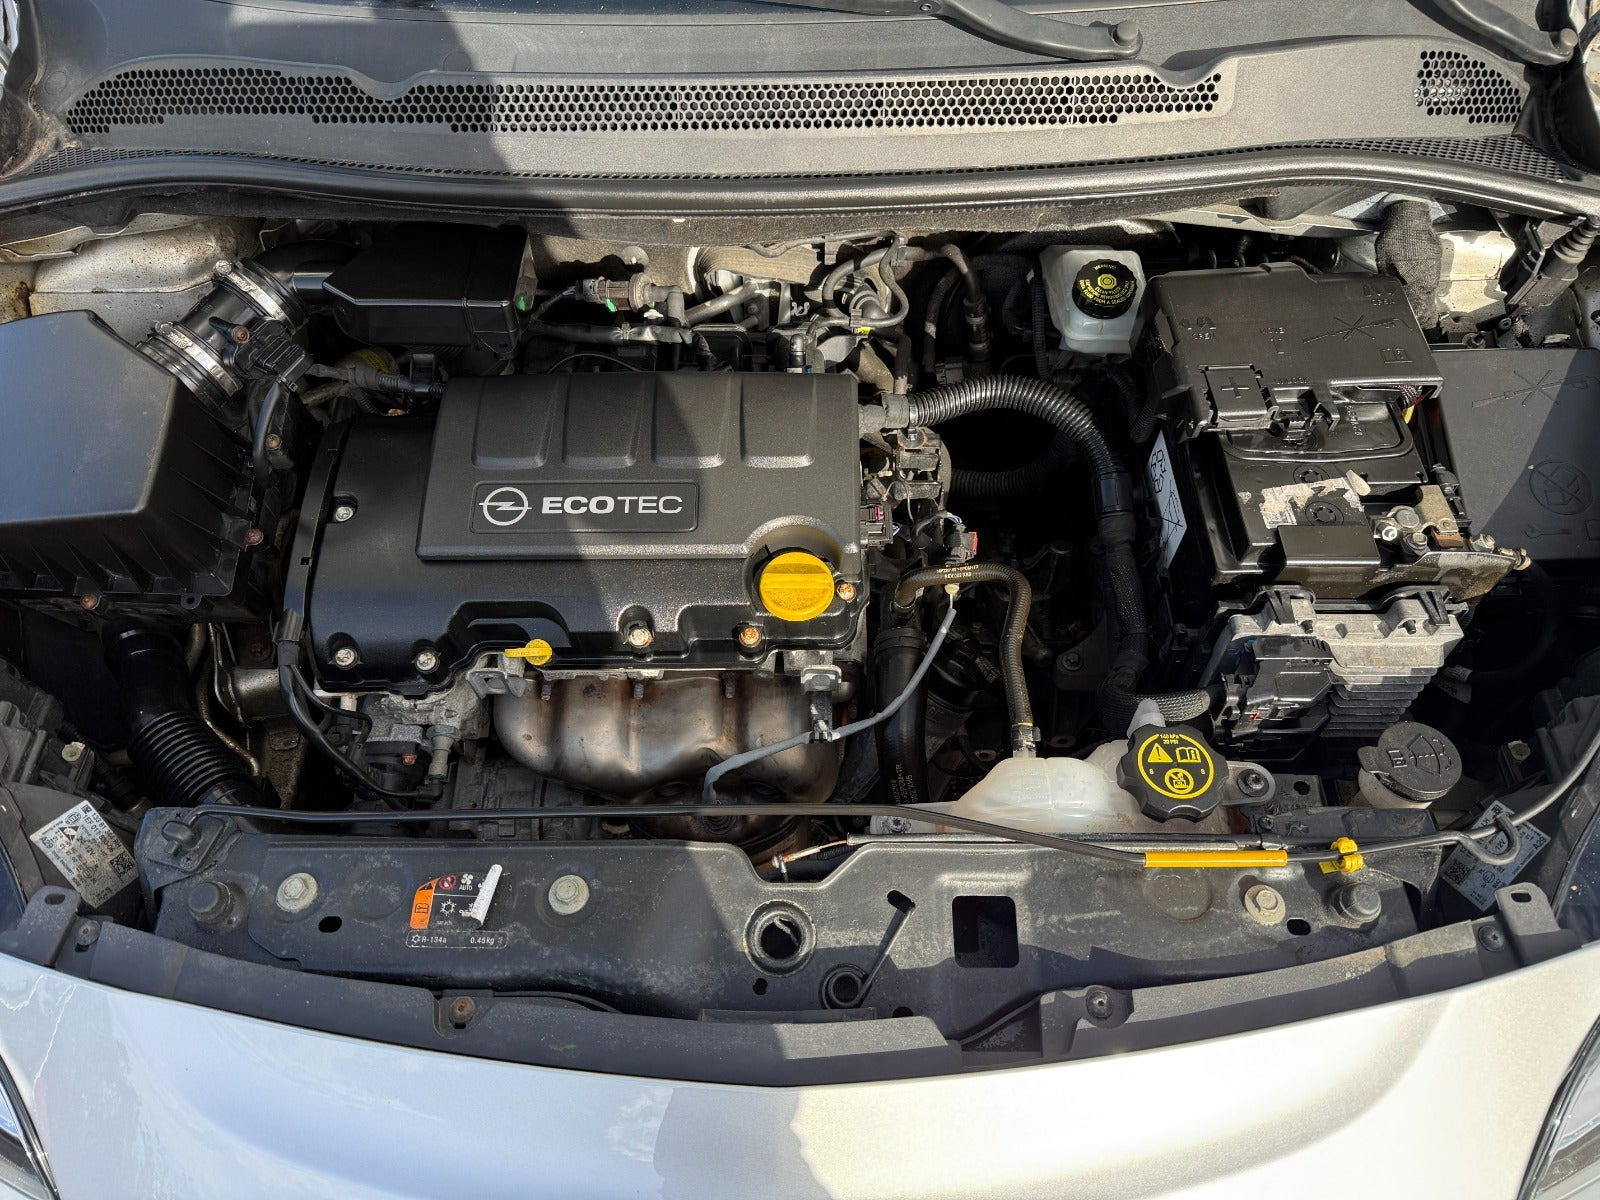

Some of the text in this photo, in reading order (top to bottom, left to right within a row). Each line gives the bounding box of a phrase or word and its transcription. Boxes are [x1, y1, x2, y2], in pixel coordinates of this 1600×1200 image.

[542, 496, 682, 514] ECOTEC
[40, 836, 53, 849] A29
[1532, 836, 1546, 850] A29
